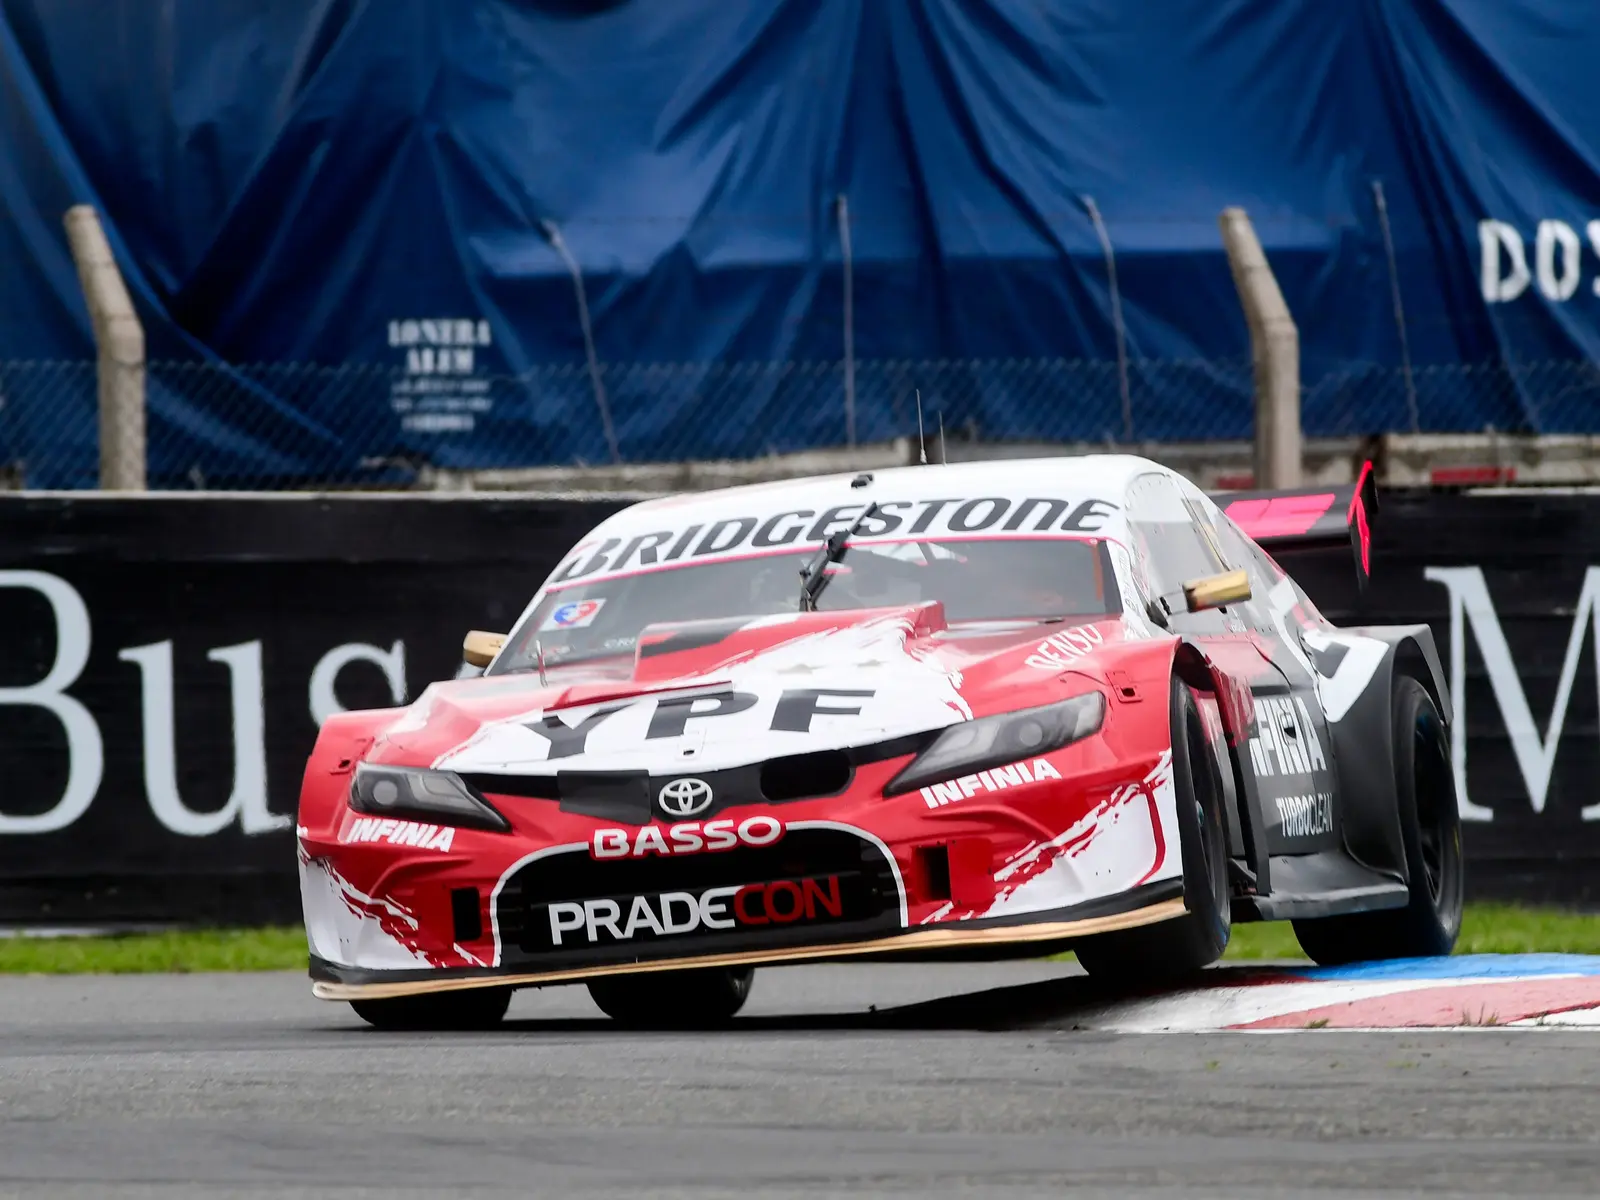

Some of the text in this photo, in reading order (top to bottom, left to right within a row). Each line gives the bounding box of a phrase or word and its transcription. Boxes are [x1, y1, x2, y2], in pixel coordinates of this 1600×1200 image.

[553, 498, 1120, 582] BRIDGESTONE
[523, 688, 876, 760] YPF
[920, 758, 1063, 809] INFINIA
[345, 818, 456, 853] INFINIA
[594, 816, 782, 858] BASSO
[548, 875, 843, 945] PRADECON
